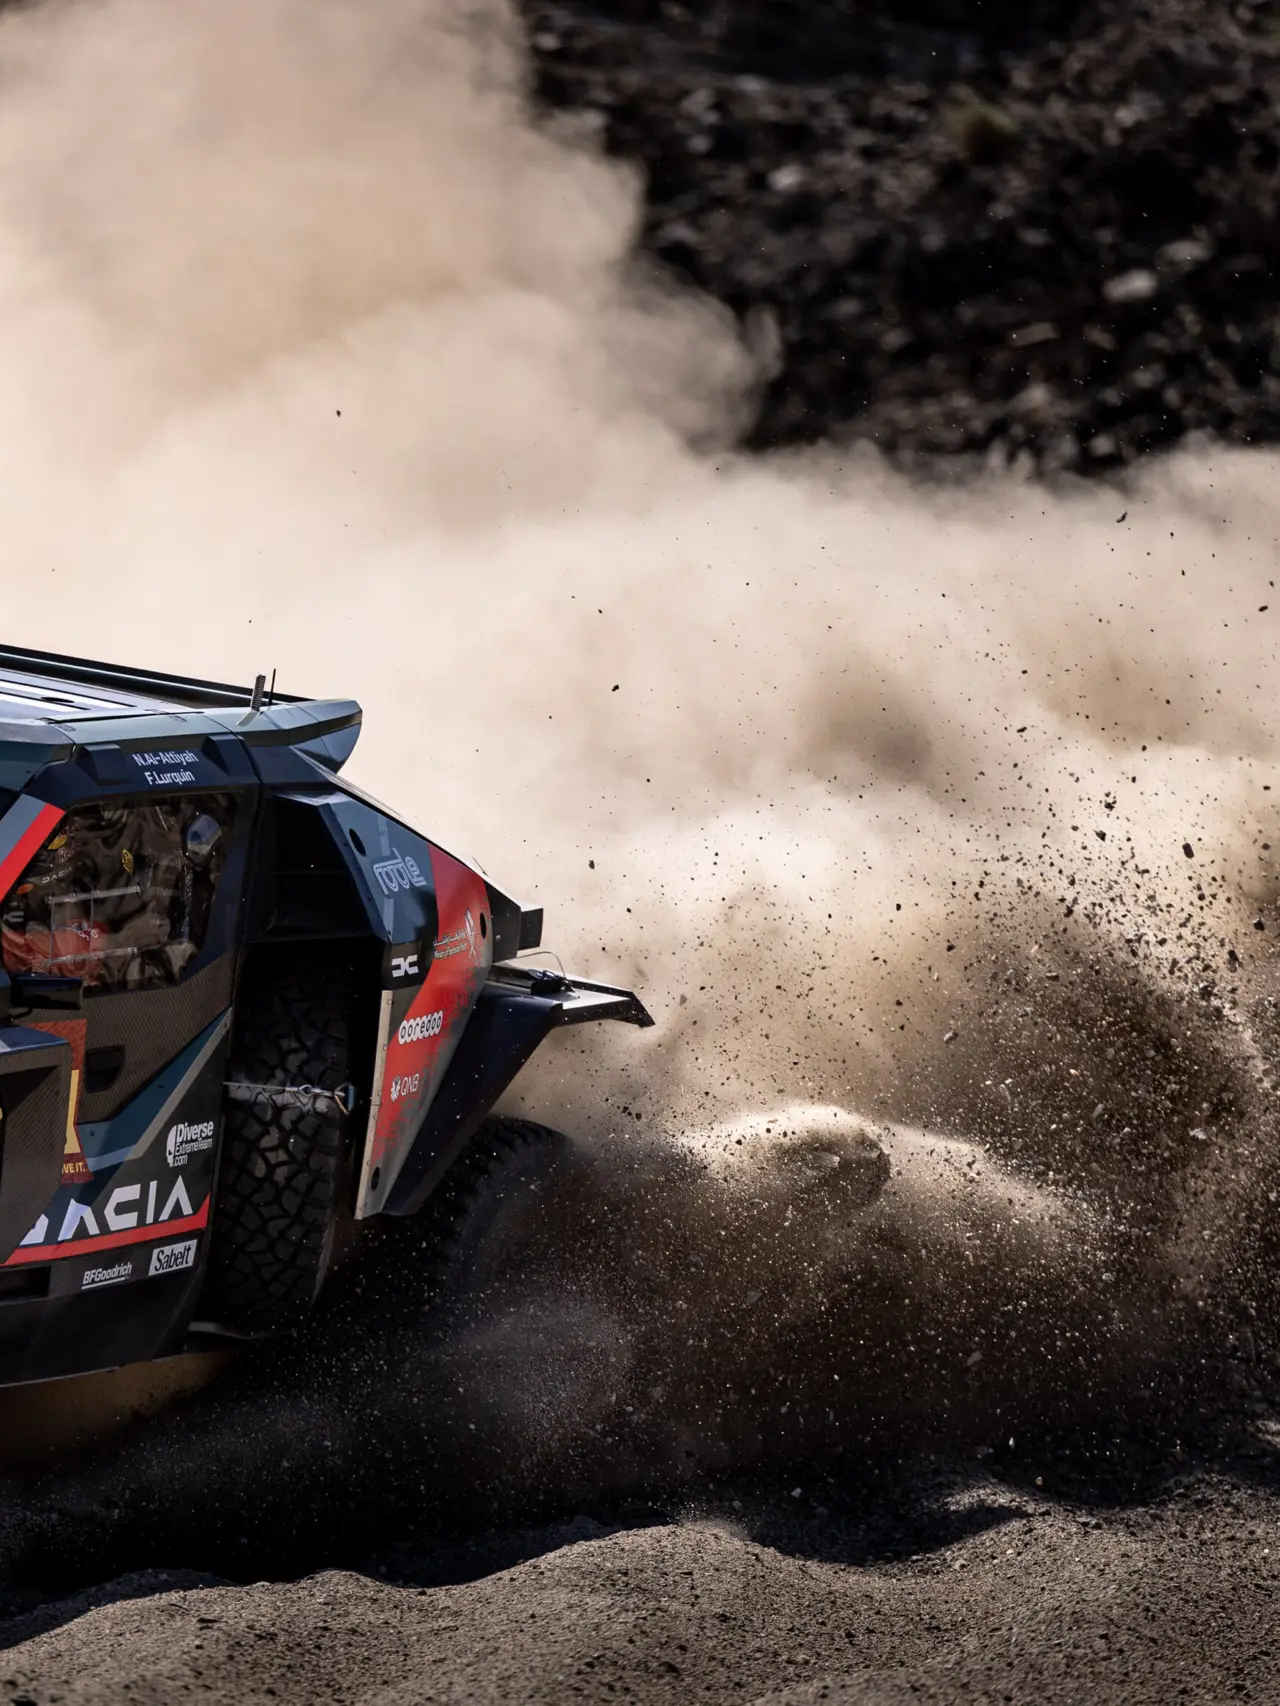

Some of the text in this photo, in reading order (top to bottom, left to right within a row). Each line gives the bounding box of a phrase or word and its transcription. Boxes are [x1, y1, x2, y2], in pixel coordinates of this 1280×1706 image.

[132, 750, 199, 766] N.Al-Attiyah
[144, 768, 195, 785] F.Lurquin
[398, 1010, 443, 1044] ooredoo
[401, 1073, 420, 1096] QNB
[176, 1120, 214, 1143] Diverse
[173, 1154, 188, 1167] .com
[154, 1245, 192, 1272] Sabelt
[82, 1262, 132, 1285] BFGoodrich
